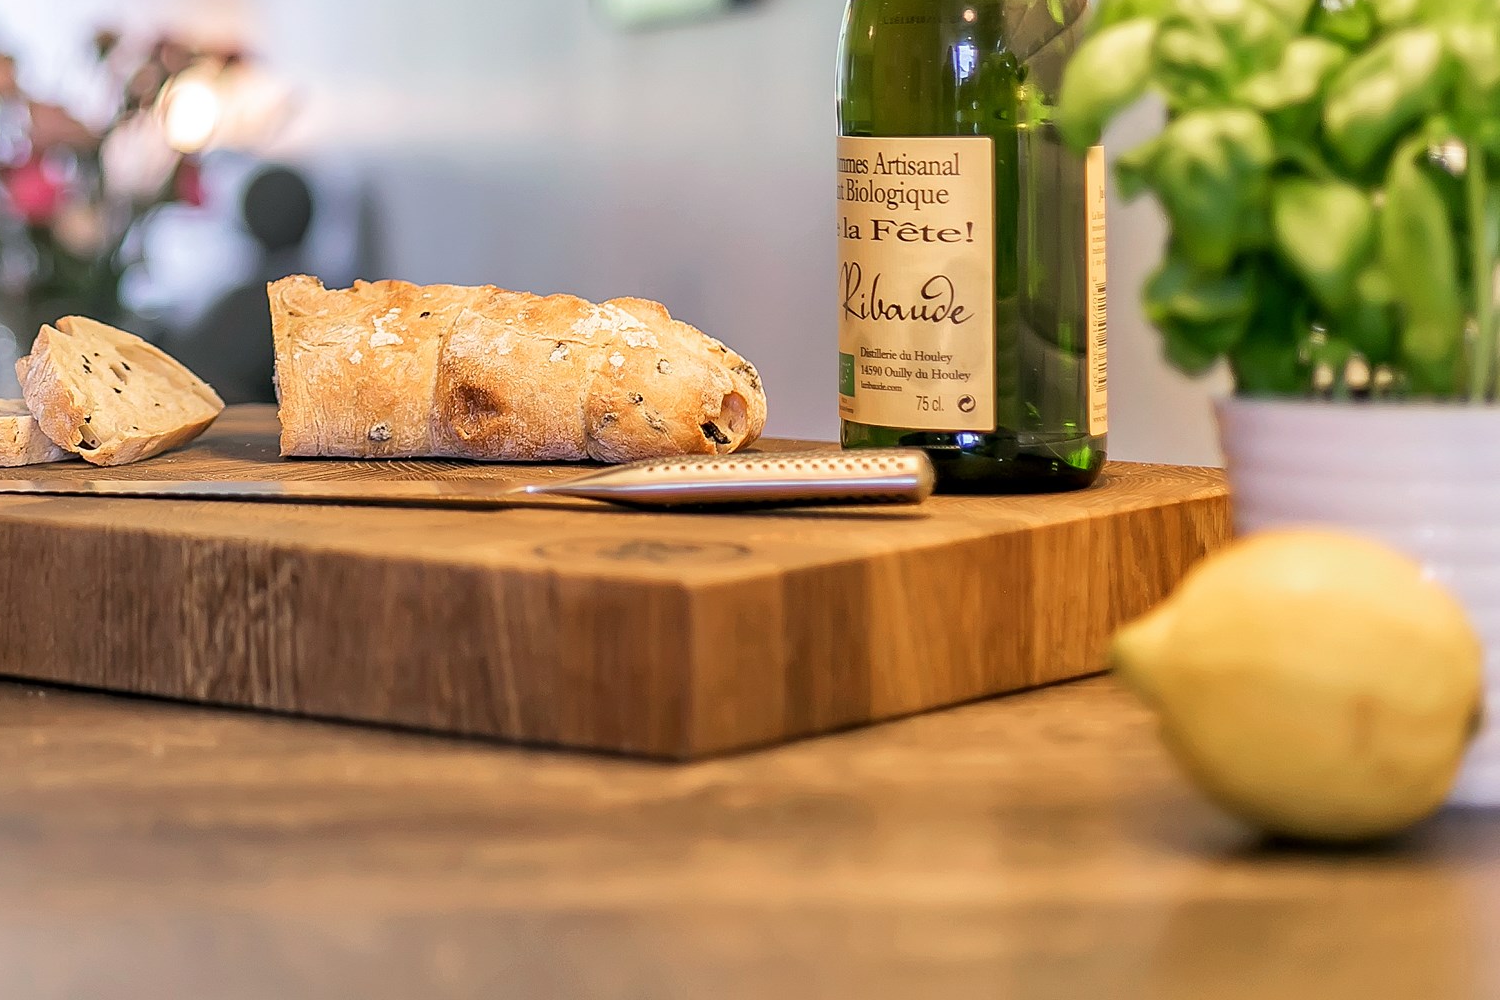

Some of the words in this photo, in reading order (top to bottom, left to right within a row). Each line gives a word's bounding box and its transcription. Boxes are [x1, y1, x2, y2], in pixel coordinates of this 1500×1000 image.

[873, 152, 961, 176] Artisanal
[846, 178, 950, 211] Biologique
[843, 217, 862, 240] la
[870, 219, 974, 243] Fête!
[838, 261, 975, 325] Ribaude
[860, 346, 897, 361] Distillerie
[899, 350, 912, 361] du
[914, 351, 953, 365] Houley
[860, 364, 883, 376] 14590
[884, 367, 913, 381] Ouilly
[915, 369, 928, 379] du
[931, 369, 971, 383] Houley
[916, 395, 930, 411] 75
[932, 395, 945, 412] cl.
